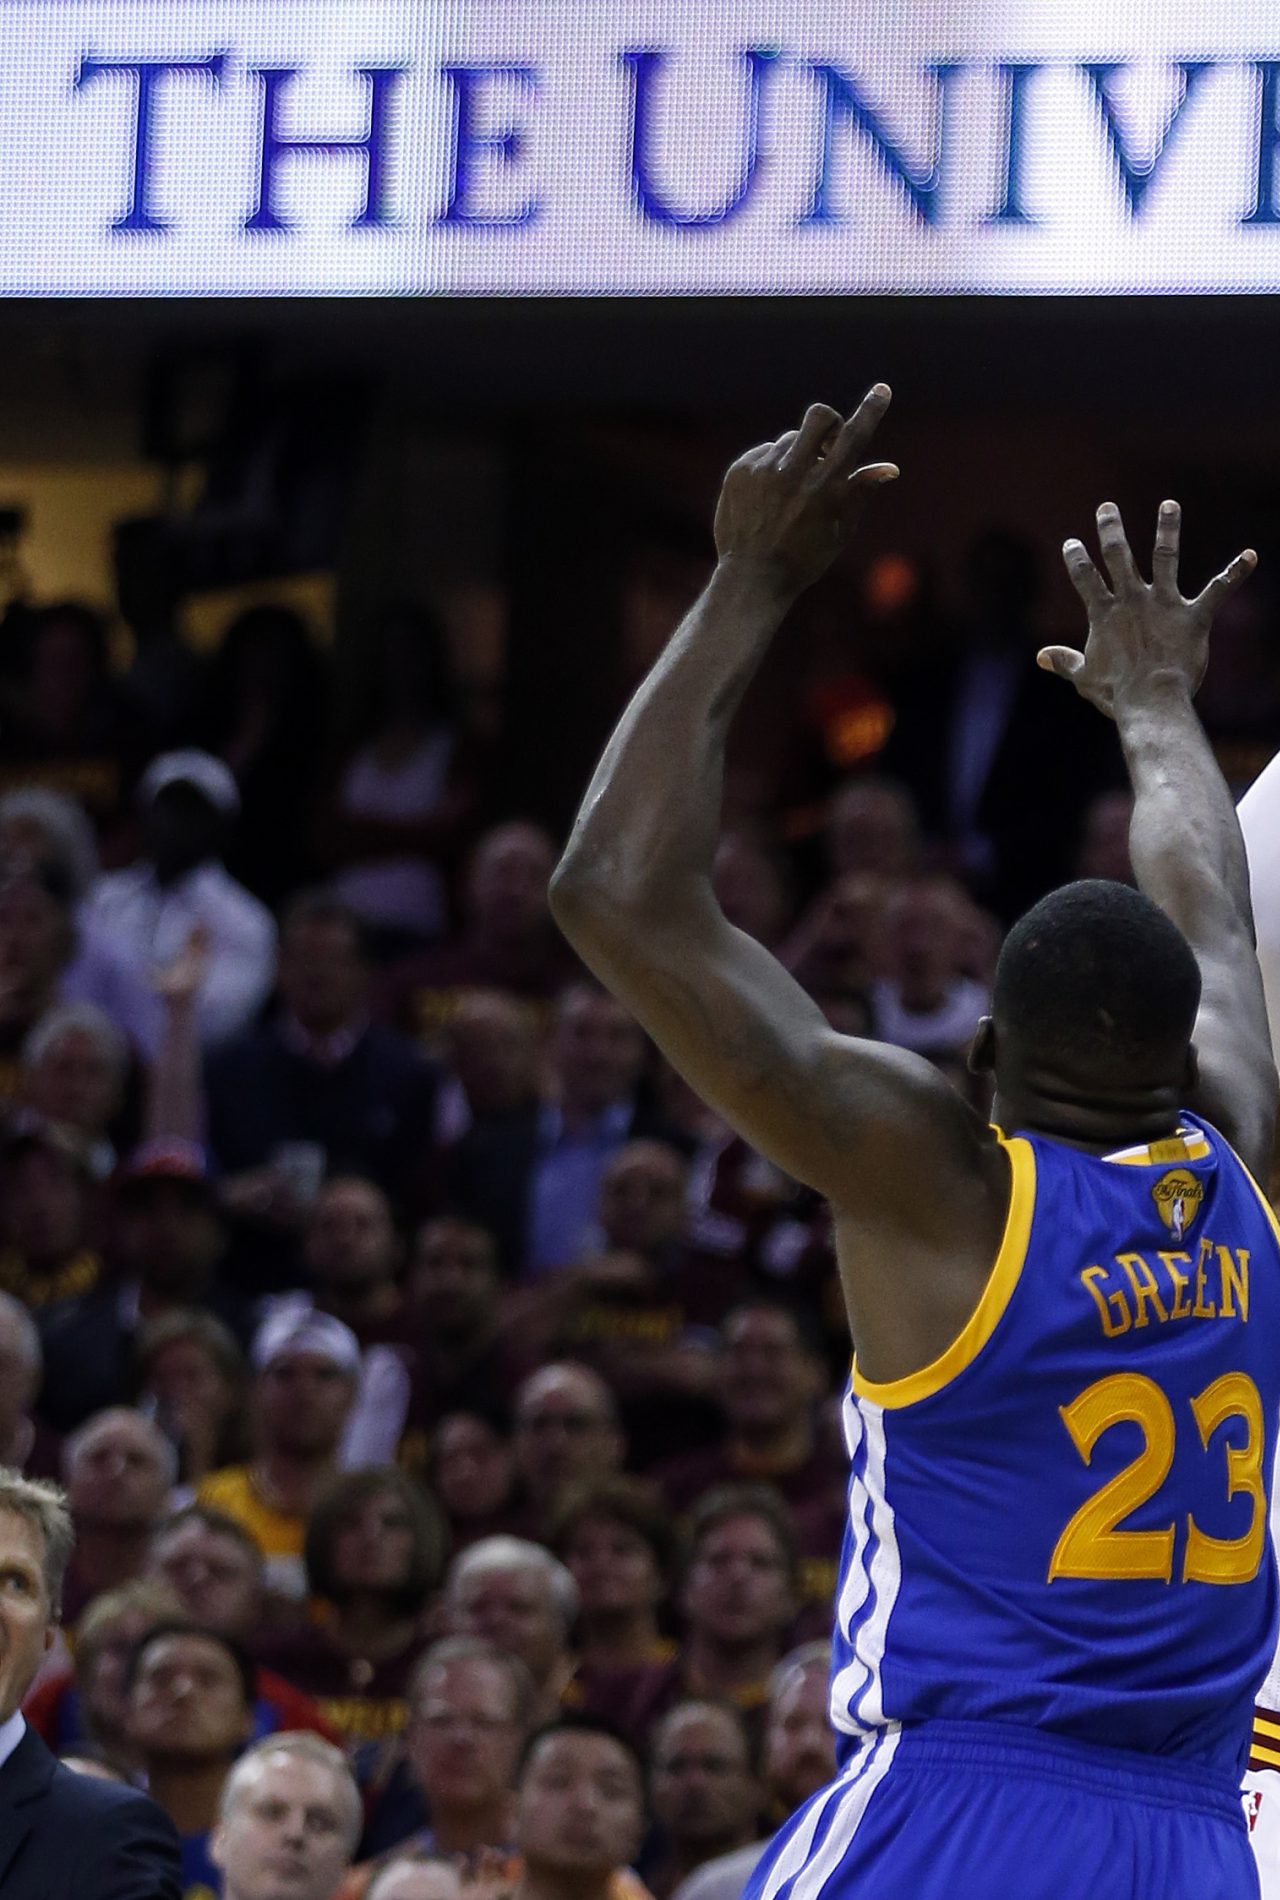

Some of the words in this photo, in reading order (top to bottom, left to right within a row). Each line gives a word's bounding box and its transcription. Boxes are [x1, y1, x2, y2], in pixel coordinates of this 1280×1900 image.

[75, 49, 541, 231] THE
[1080, 1237, 1251, 1339] GREEN
[1047, 1371, 1268, 1586] 23
